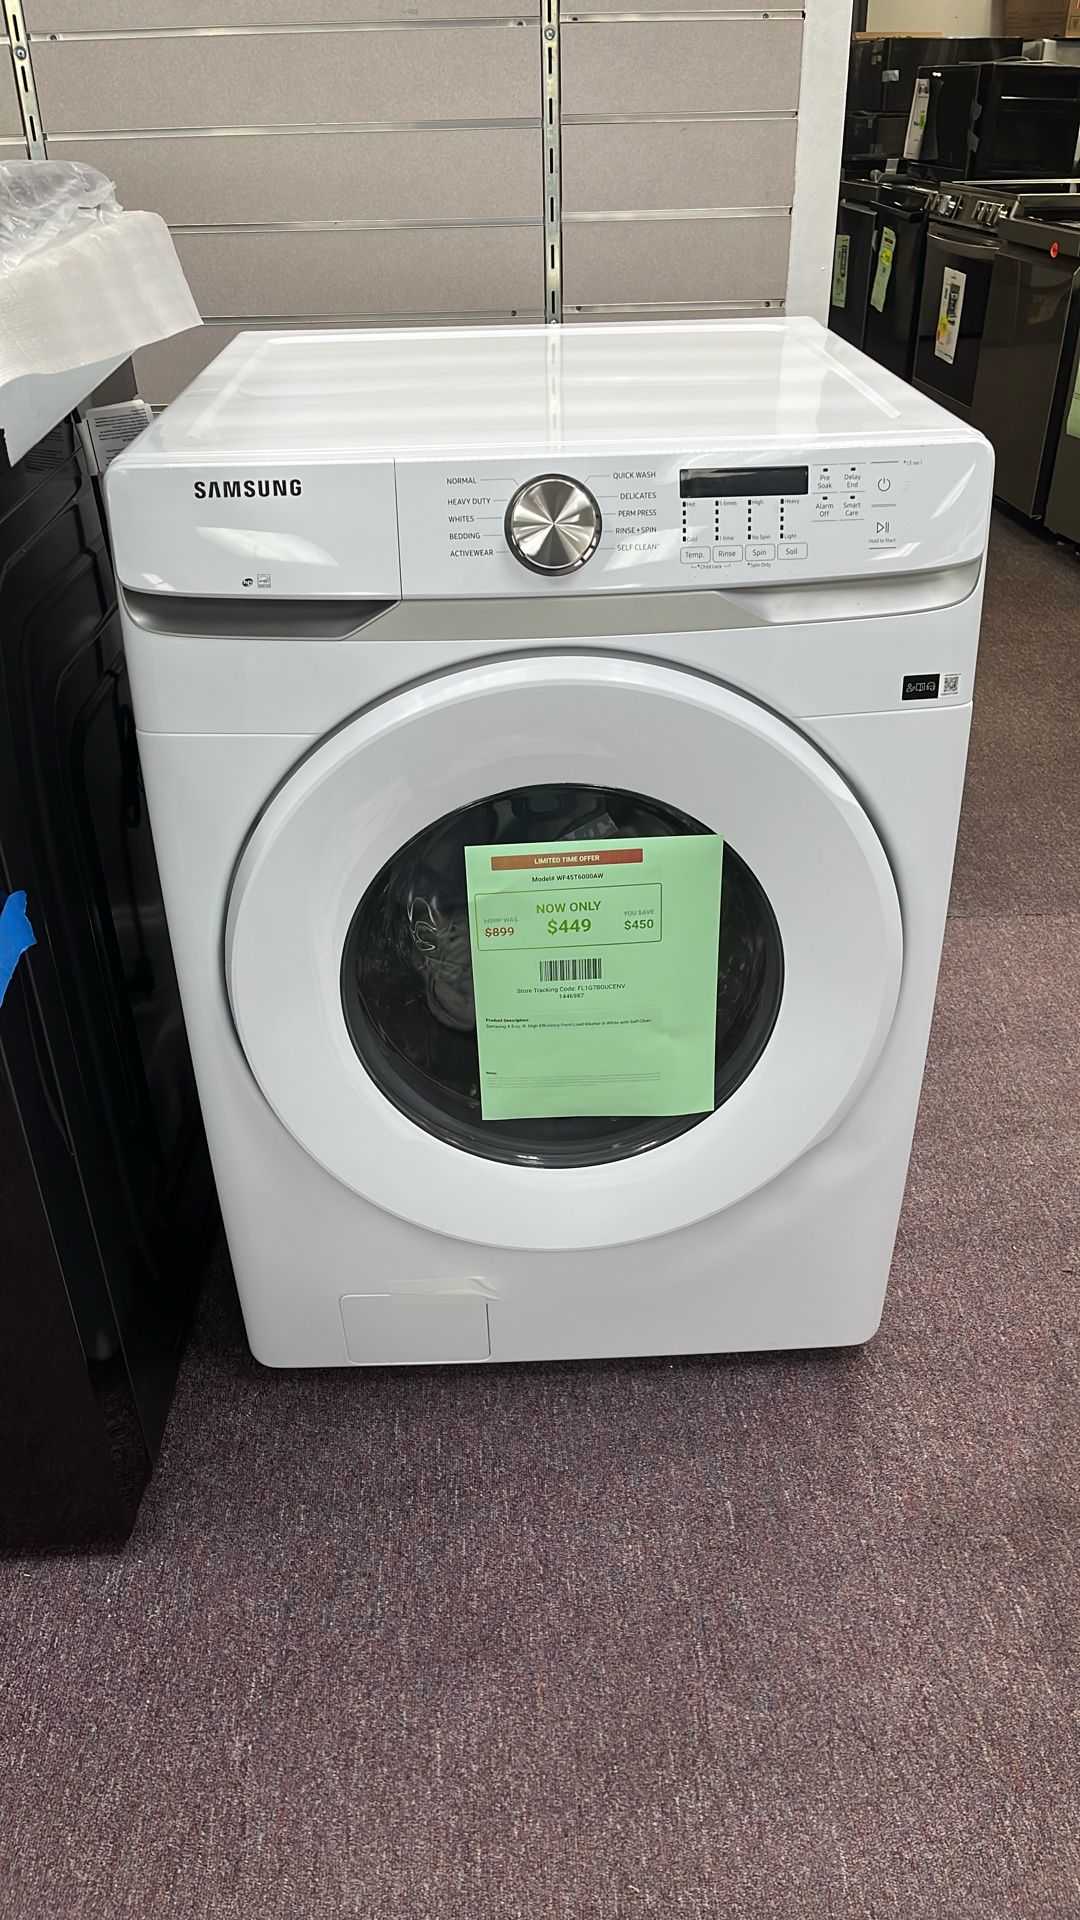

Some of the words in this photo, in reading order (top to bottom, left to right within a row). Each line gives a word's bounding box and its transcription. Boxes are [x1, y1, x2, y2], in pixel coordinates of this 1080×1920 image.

[447, 477, 477, 485] NORMAL
[194, 479, 302, 499] SAMSUNG
[620, 491, 657, 500] DELICATES
[447, 498, 471, 506] HEAVY
[472, 497, 491, 505] DUTY
[819, 510, 830, 518] Off
[448, 515, 475, 523] WHITES
[615, 527, 635, 535] RINSE
[449, 532, 481, 540] BEDDING
[450, 549, 494, 557] ACTIVEWEAR
[685, 551, 704, 559] Temp.
[752, 549, 767, 557] Spin
[534, 857, 561, 865] LIMITED
[556, 873, 604, 881] WF45T6000AW
[536, 903, 566, 914] NOW
[569, 901, 602, 912] ONLY
[547, 918, 592, 935] $449
[624, 919, 654, 931] $450
[485, 926, 515, 938] $899
[533, 986, 558, 994] Tracking
